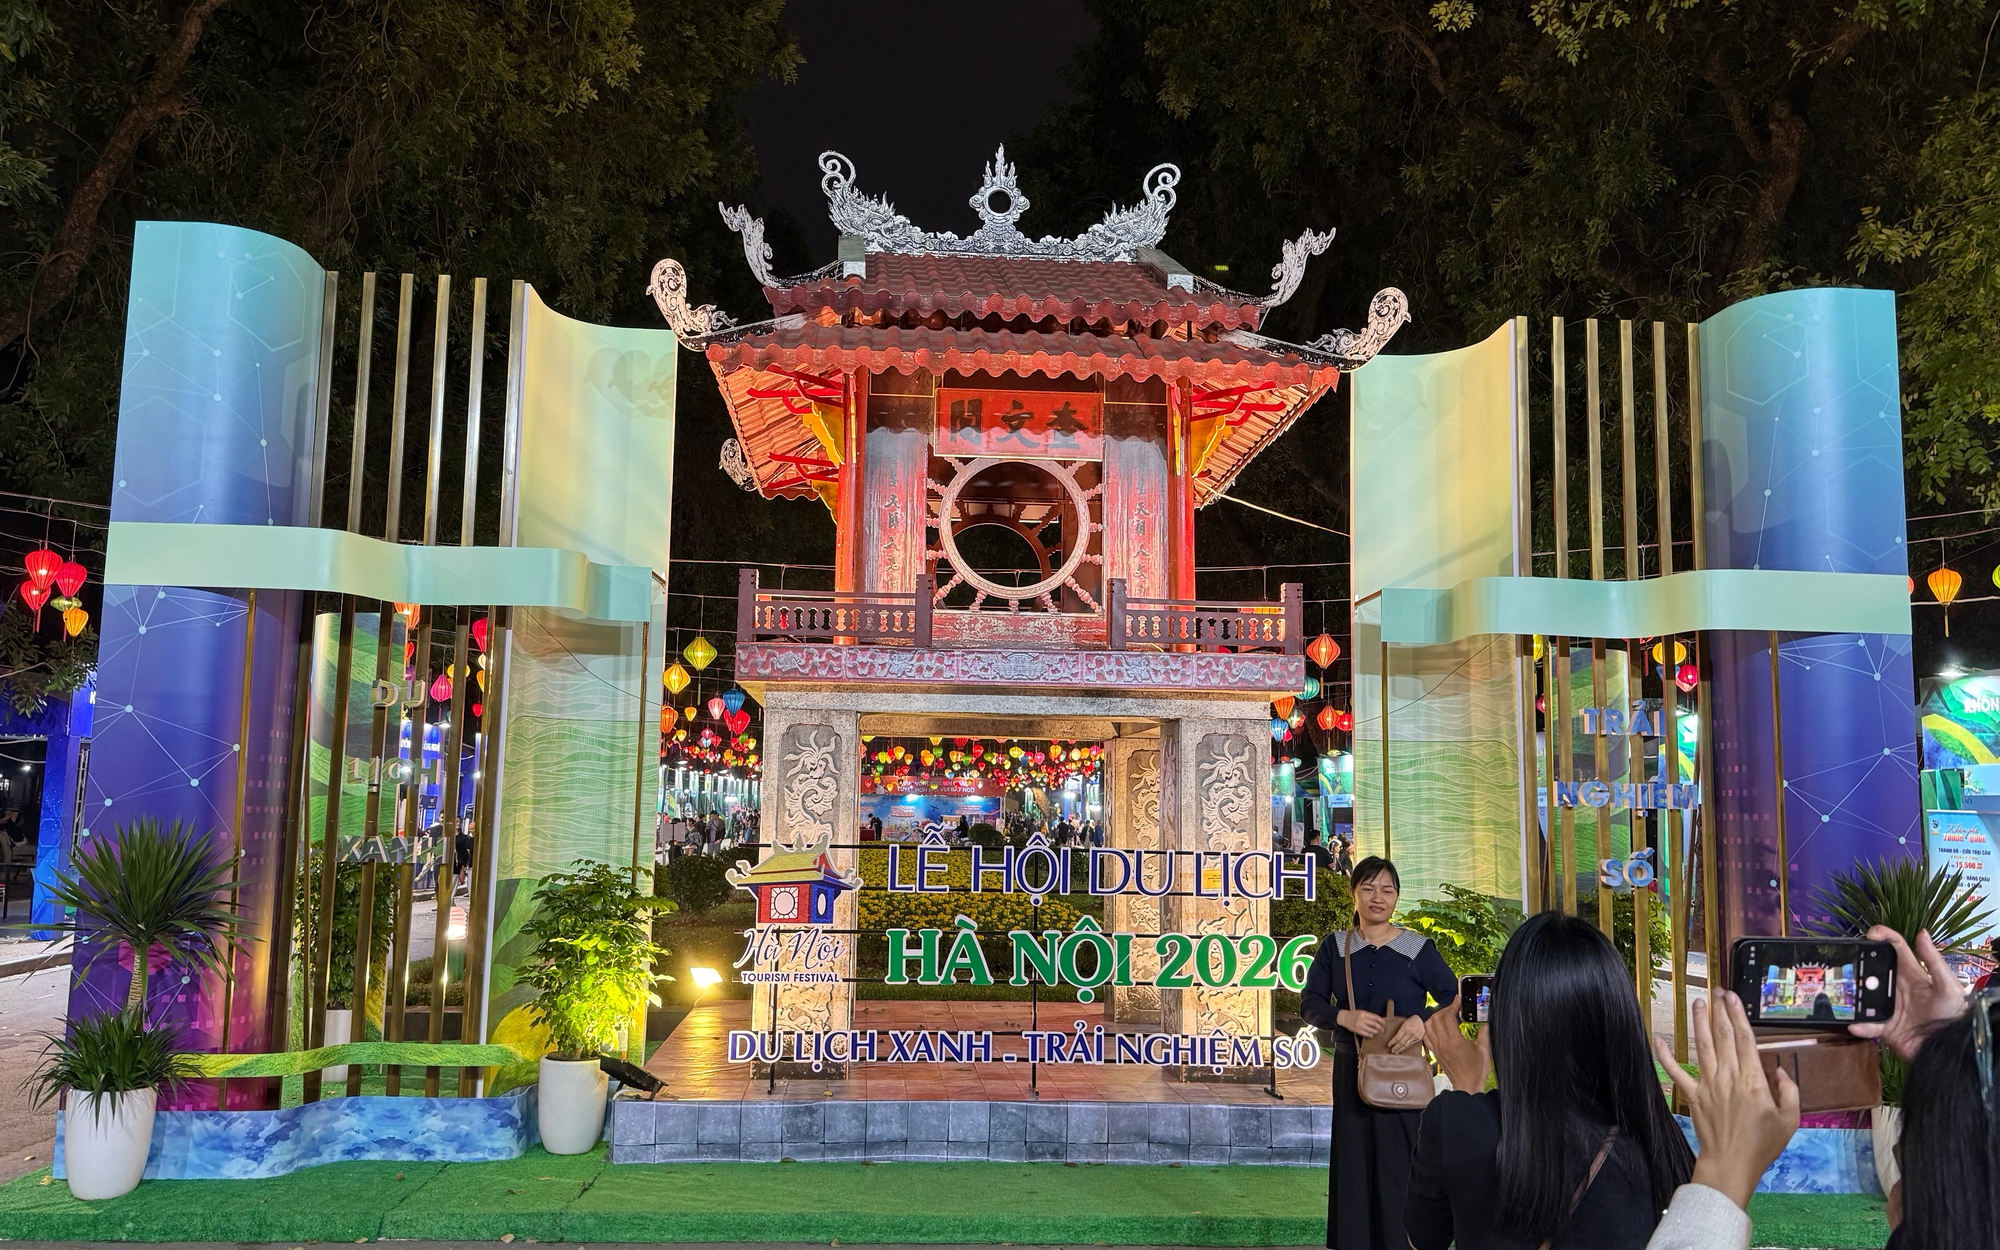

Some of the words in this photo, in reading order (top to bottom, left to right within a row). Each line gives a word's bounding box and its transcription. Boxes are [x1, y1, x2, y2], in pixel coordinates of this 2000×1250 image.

[372, 678, 426, 707] DU
[1580, 699, 1666, 736] TRẢI
[347, 755, 441, 793] LỊCH
[1553, 775, 1699, 818] NGHIỆM
[335, 835, 448, 864] XANH
[887, 823, 951, 894] LỄ
[972, 832, 1070, 906] HỘI
[1089, 847, 1174, 896] DU
[1194, 851, 1316, 906] LỊCH
[1600, 847, 1655, 887] SỐ
[735, 923, 783, 966] Hà
[788, 927, 845, 969] Nội
[885, 914, 992, 986] HÀ
[1009, 915, 1138, 1003] NỘI
[1155, 934, 1318, 991] 2026
[742, 973, 790, 982] TOURISM
[793, 973, 840, 982] FESTIVAL
[728, 1031, 783, 1063] DU
[795, 1030, 877, 1072] LỊCH
[888, 1030, 992, 1064] XANH
[1025, 1020, 1104, 1066] TRẢI
[1116, 1029, 1270, 1075] NGHIỆM
[1275, 1023, 1320, 1070] SỐ
